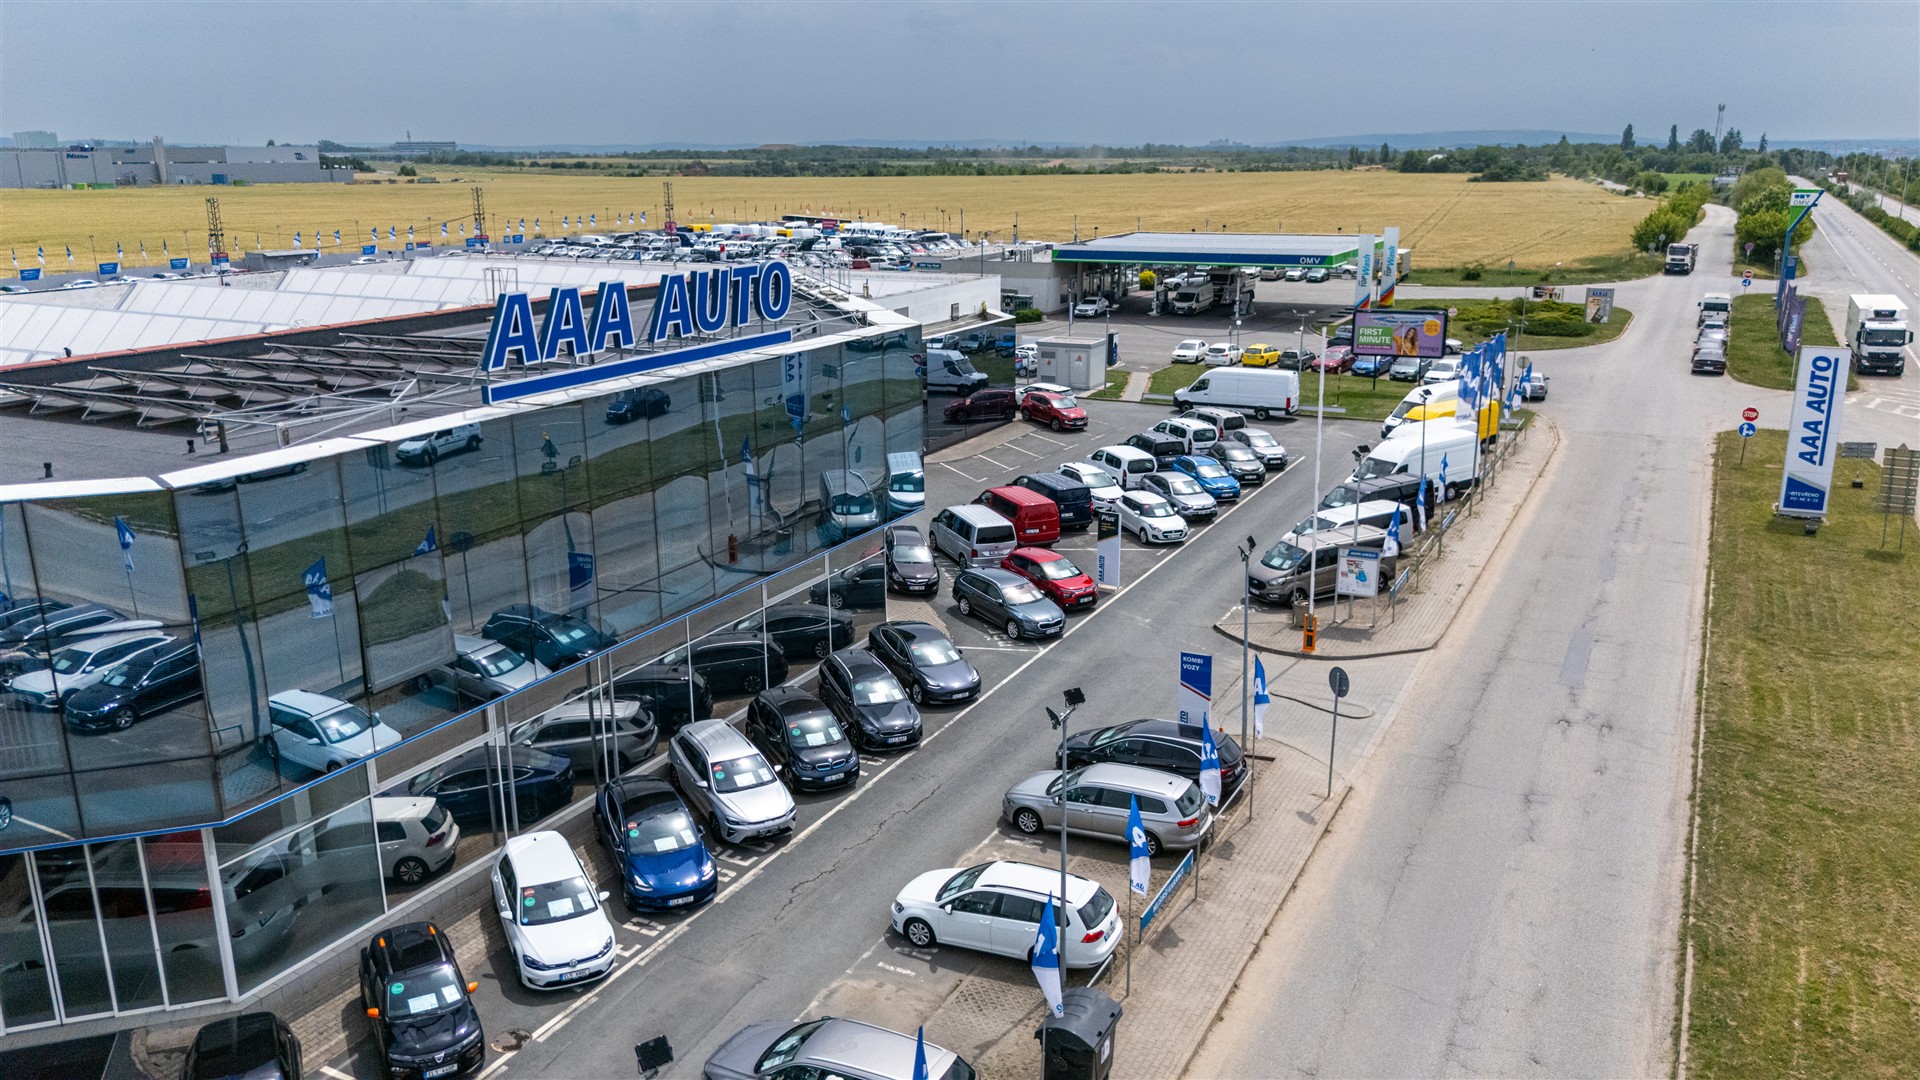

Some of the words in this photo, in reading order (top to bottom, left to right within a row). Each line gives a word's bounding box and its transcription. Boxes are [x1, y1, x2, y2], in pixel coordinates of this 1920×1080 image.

[481, 280, 636, 372] AAA
[648, 260, 793, 344] AUTO
[1359, 328, 1383, 336] FIRST
[1359, 336, 1391, 344] MINUTE
[1806, 355, 1832, 415] AUTO
[1798, 420, 1823, 466] AAA
[1183, 656, 1203, 664] KOMBI
